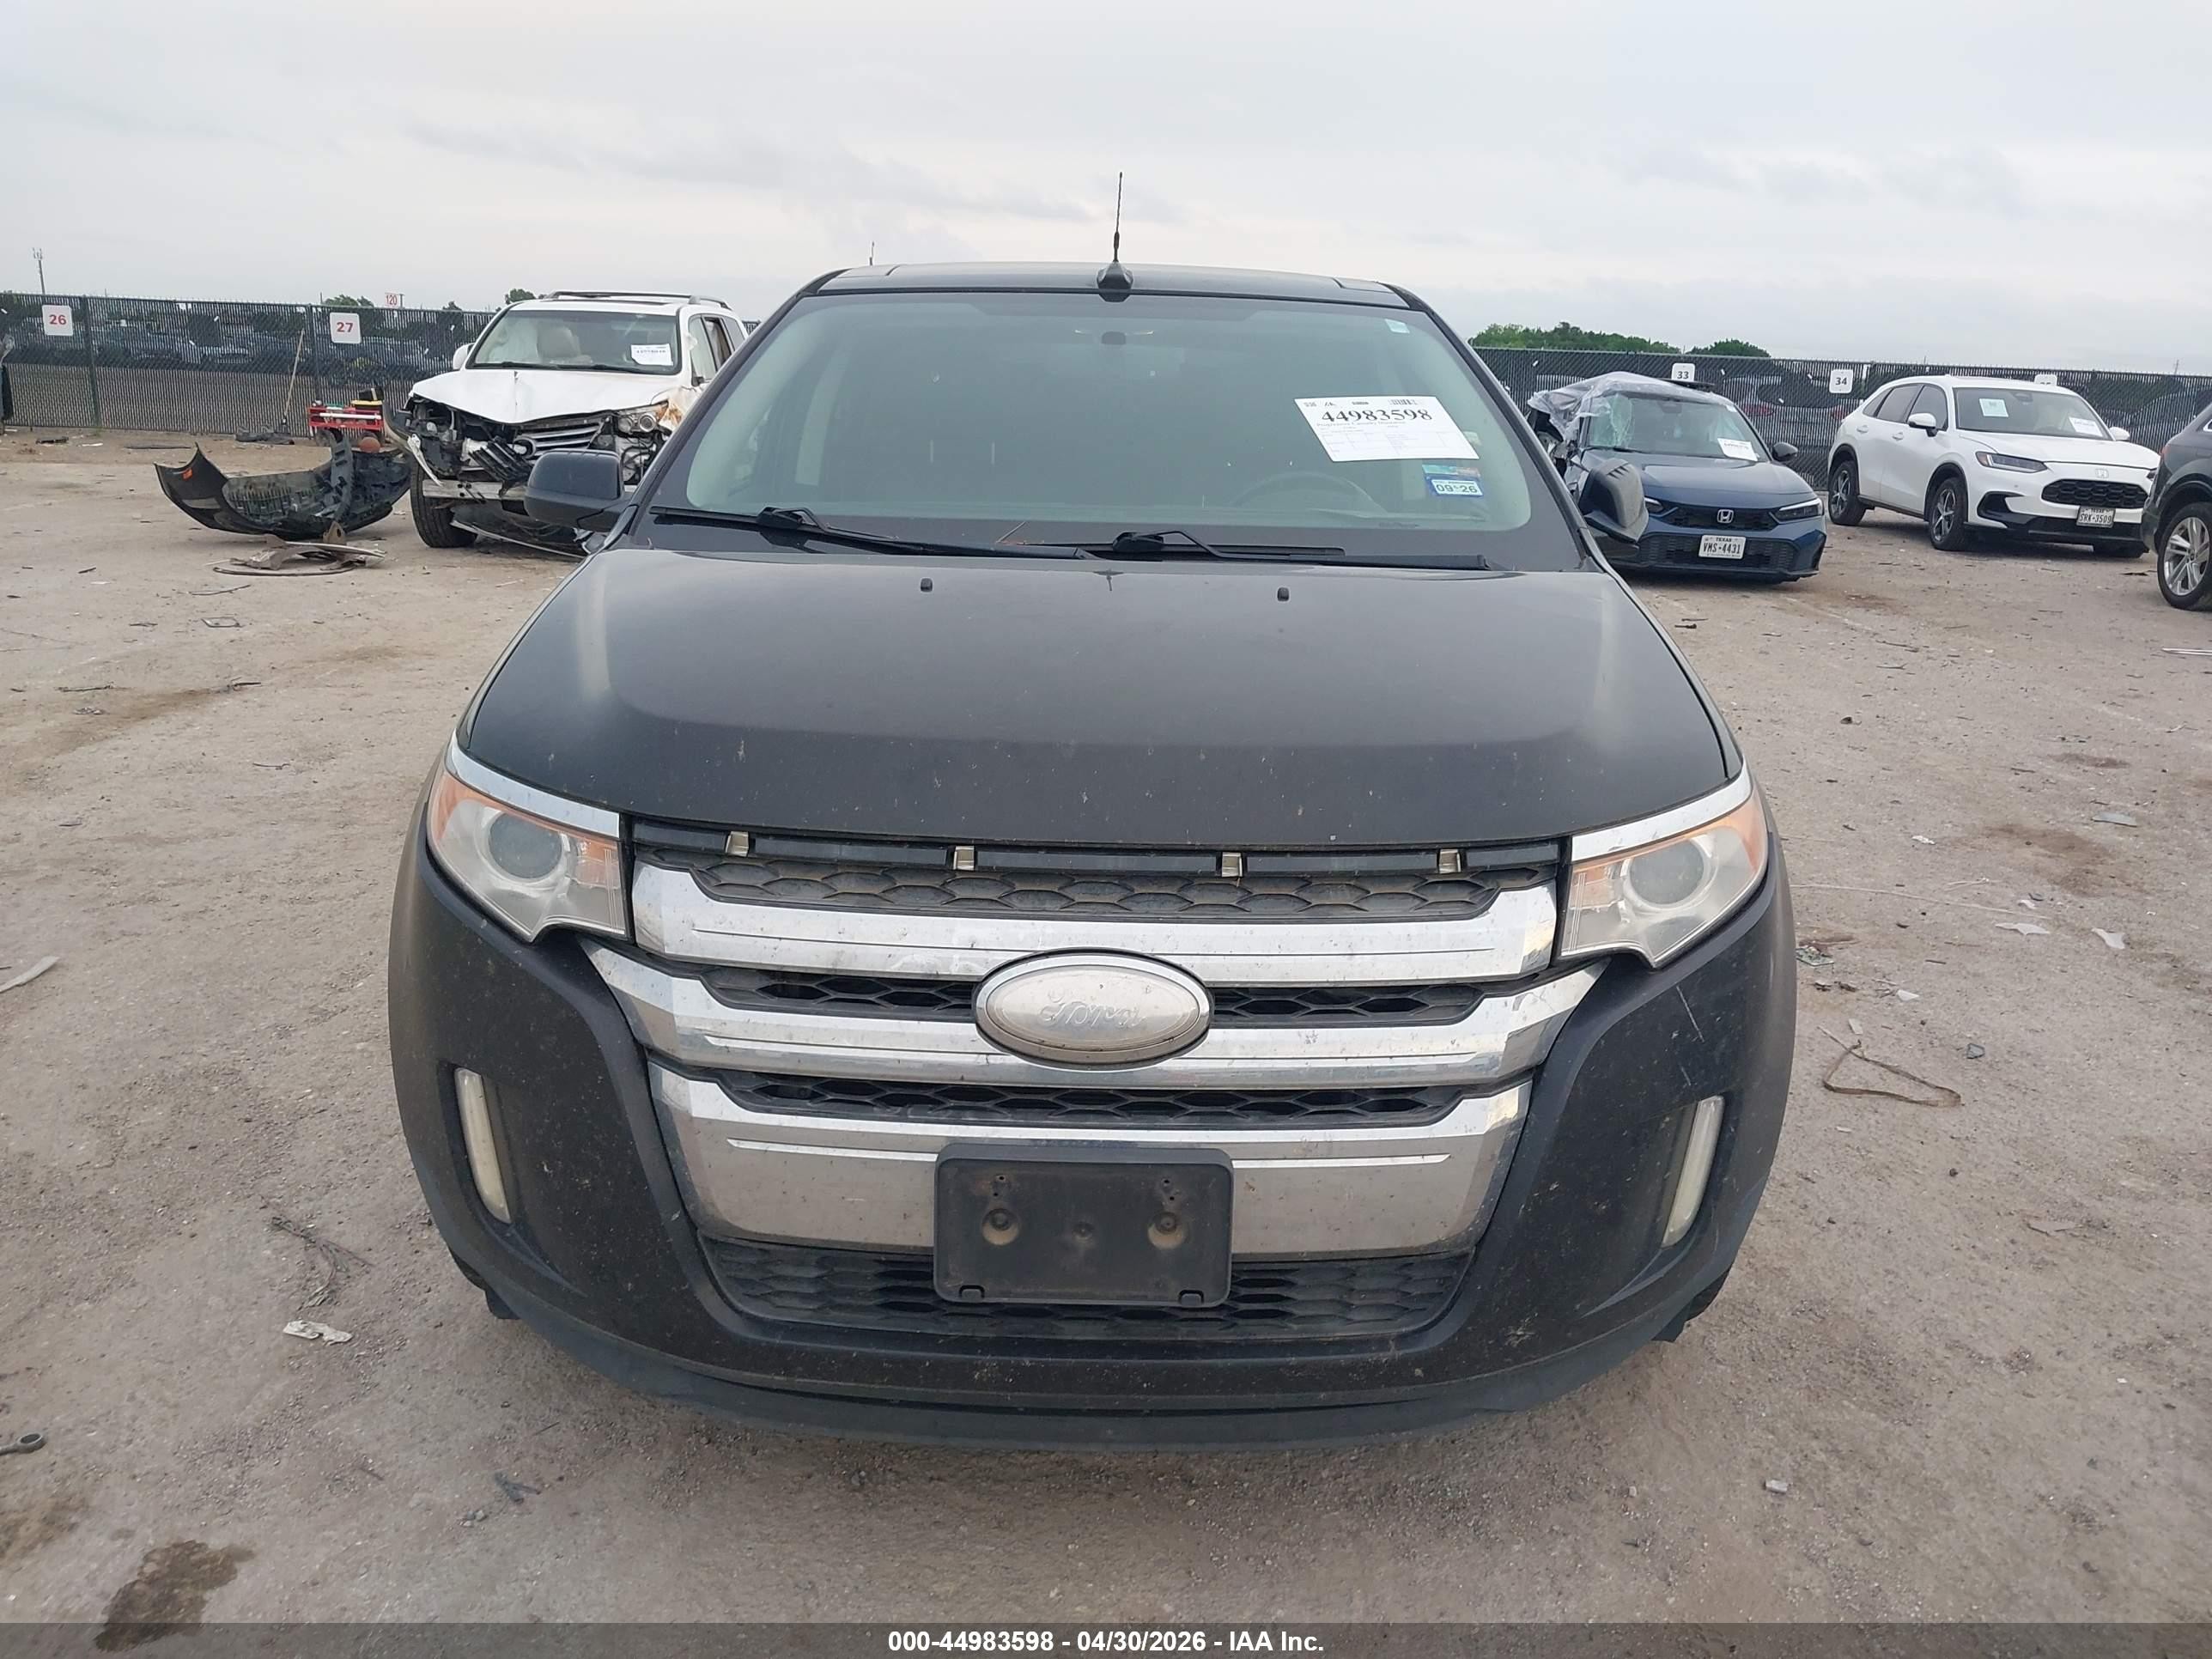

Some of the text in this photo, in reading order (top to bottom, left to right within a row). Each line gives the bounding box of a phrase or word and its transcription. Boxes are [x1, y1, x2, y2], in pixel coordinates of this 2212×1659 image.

[386, 295, 398, 306] 120
[49, 313, 67, 325] 26
[336, 321, 354, 333] 27
[1676, 370, 1689, 380] 33
[1835, 377, 1847, 386] 34
[1321, 409, 1433, 422] 44983598
